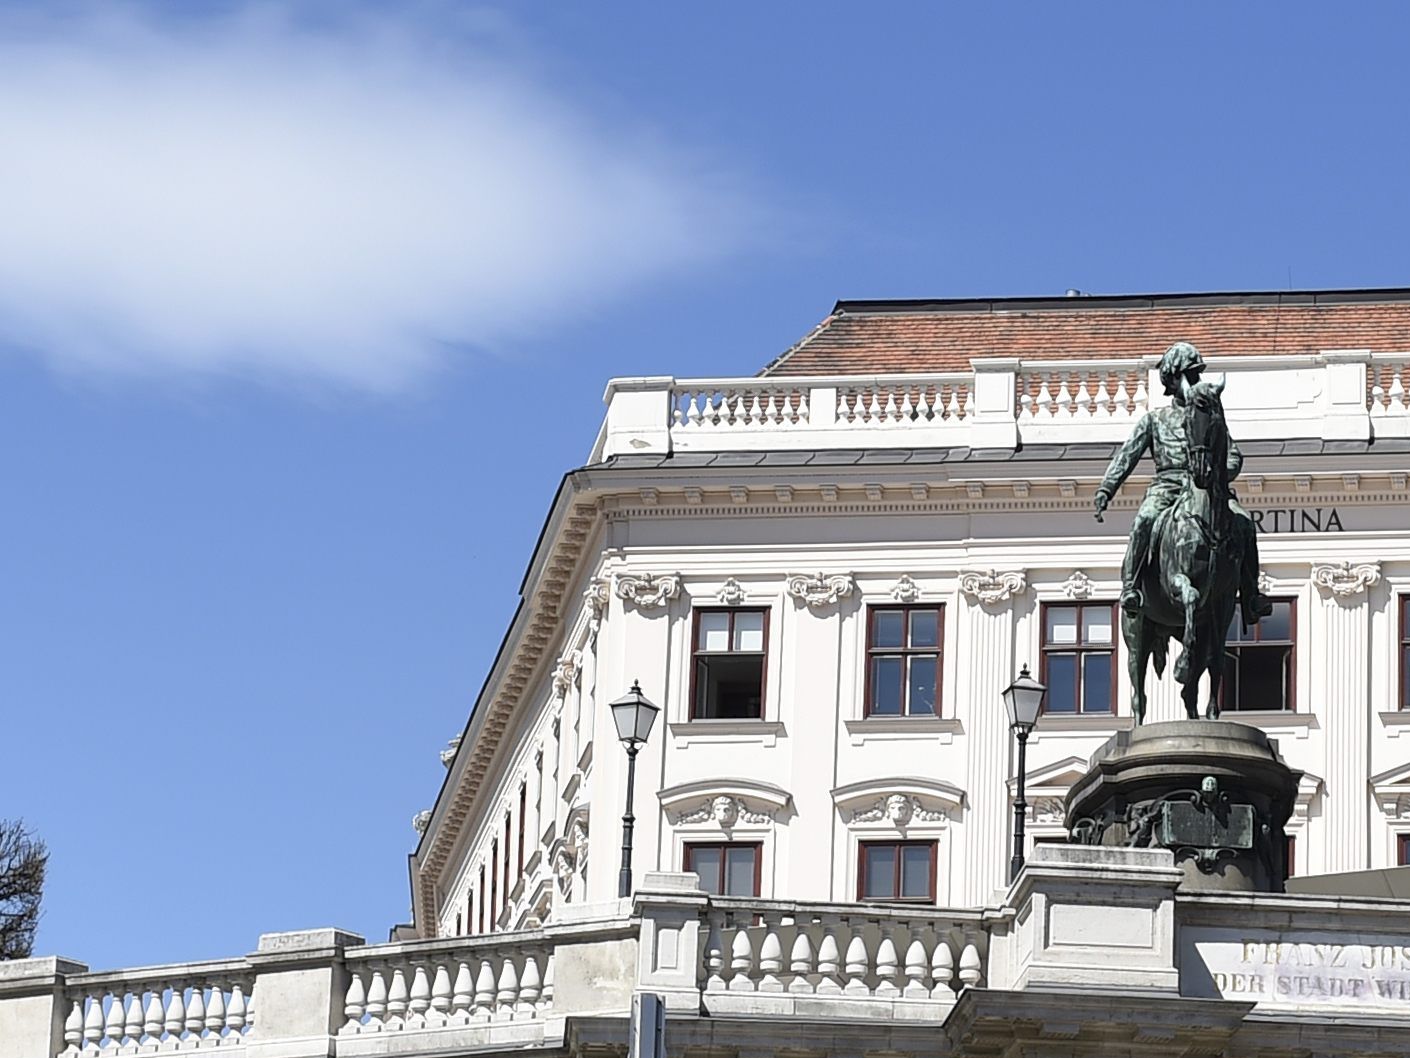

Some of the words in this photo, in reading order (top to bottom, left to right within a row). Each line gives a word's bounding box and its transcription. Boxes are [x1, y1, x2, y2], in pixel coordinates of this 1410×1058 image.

[1240, 939, 1348, 969] FRANZ
[1212, 971, 1266, 995] DER
[1276, 974, 1365, 999] STADT
